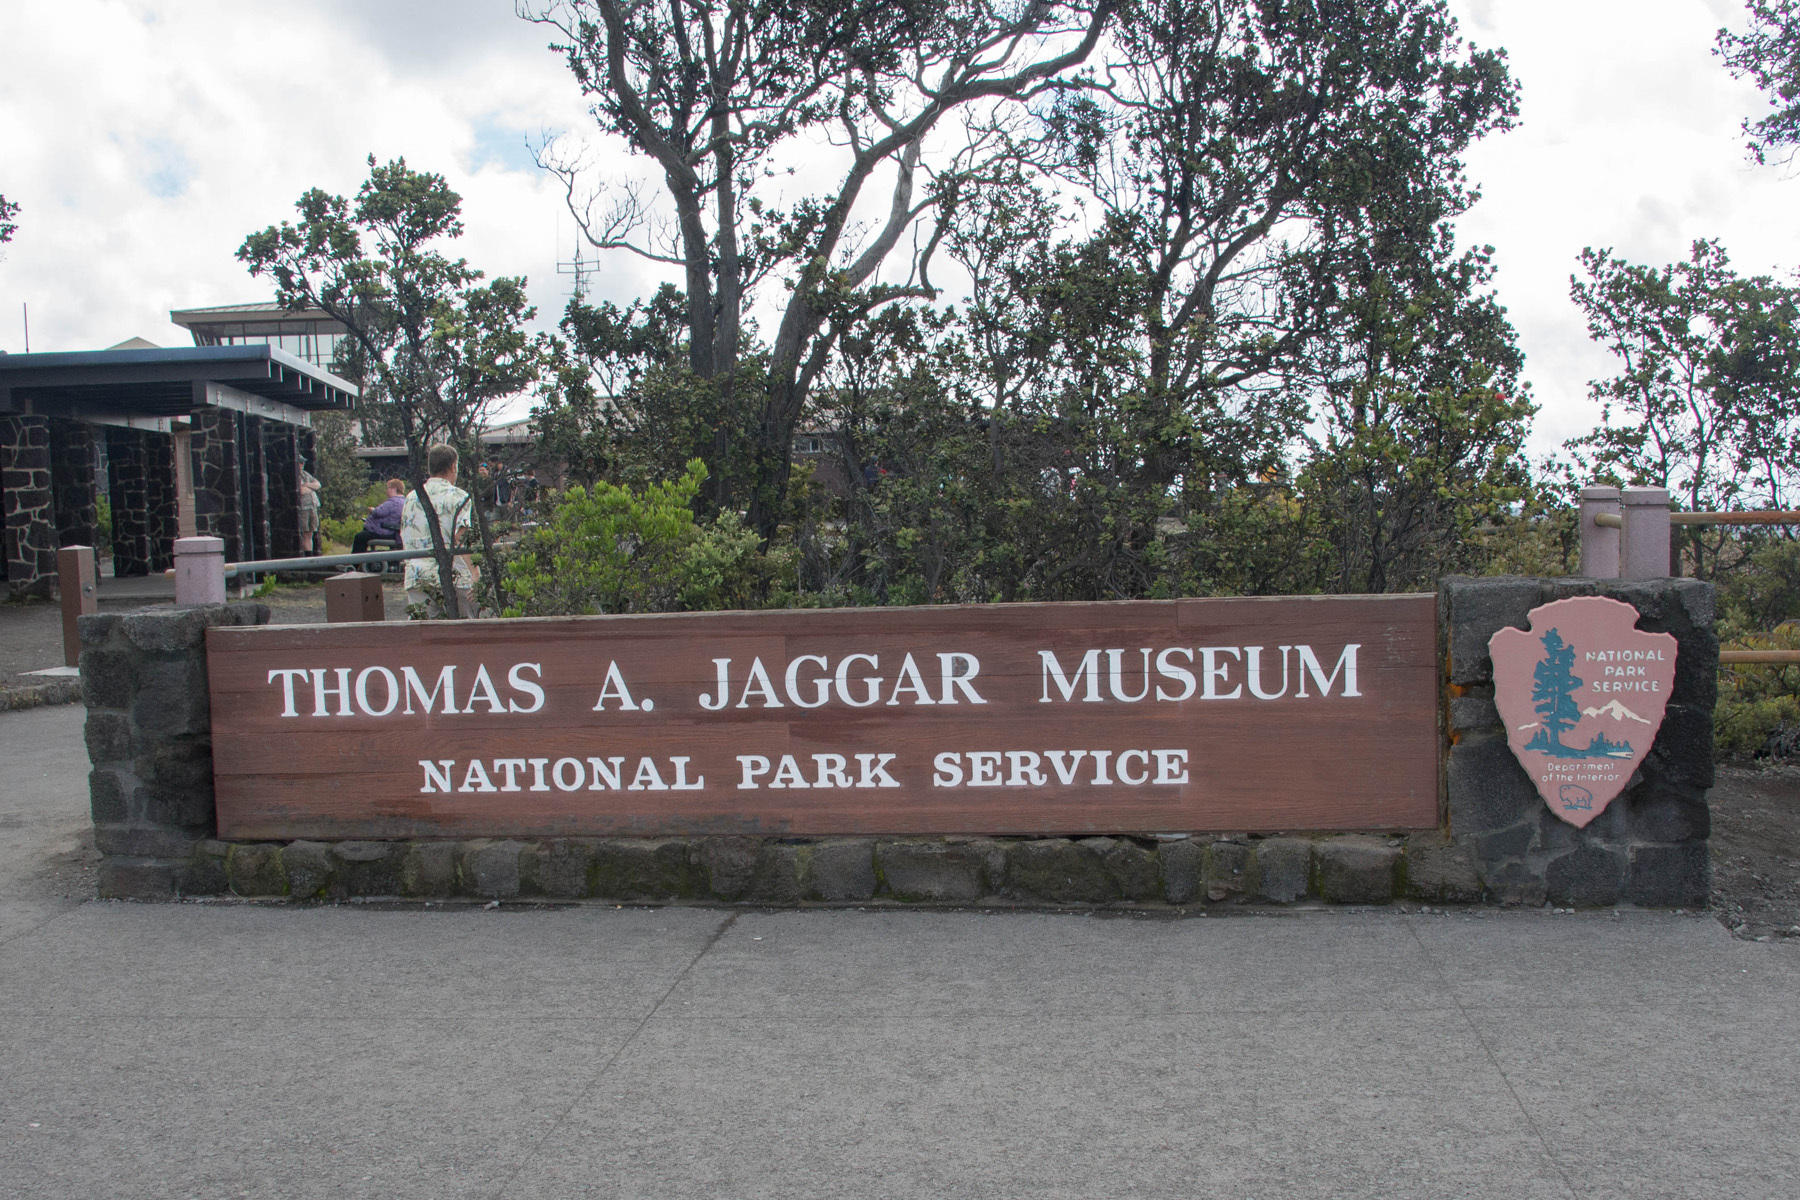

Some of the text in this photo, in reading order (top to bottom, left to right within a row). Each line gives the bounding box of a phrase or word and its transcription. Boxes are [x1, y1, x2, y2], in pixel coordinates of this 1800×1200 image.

[1585, 650, 1665, 662] NATIONAL
[1605, 666, 1646, 677] PARK
[268, 643, 1363, 717] THOMAS A. JAGGAR MUSEUM
[1592, 681, 1660, 692] SERVICE
[418, 748, 1191, 793] NATIONAL PARK SERVICE
[1547, 762, 1614, 772] Department
[1541, 773, 1620, 782] of the Interior
